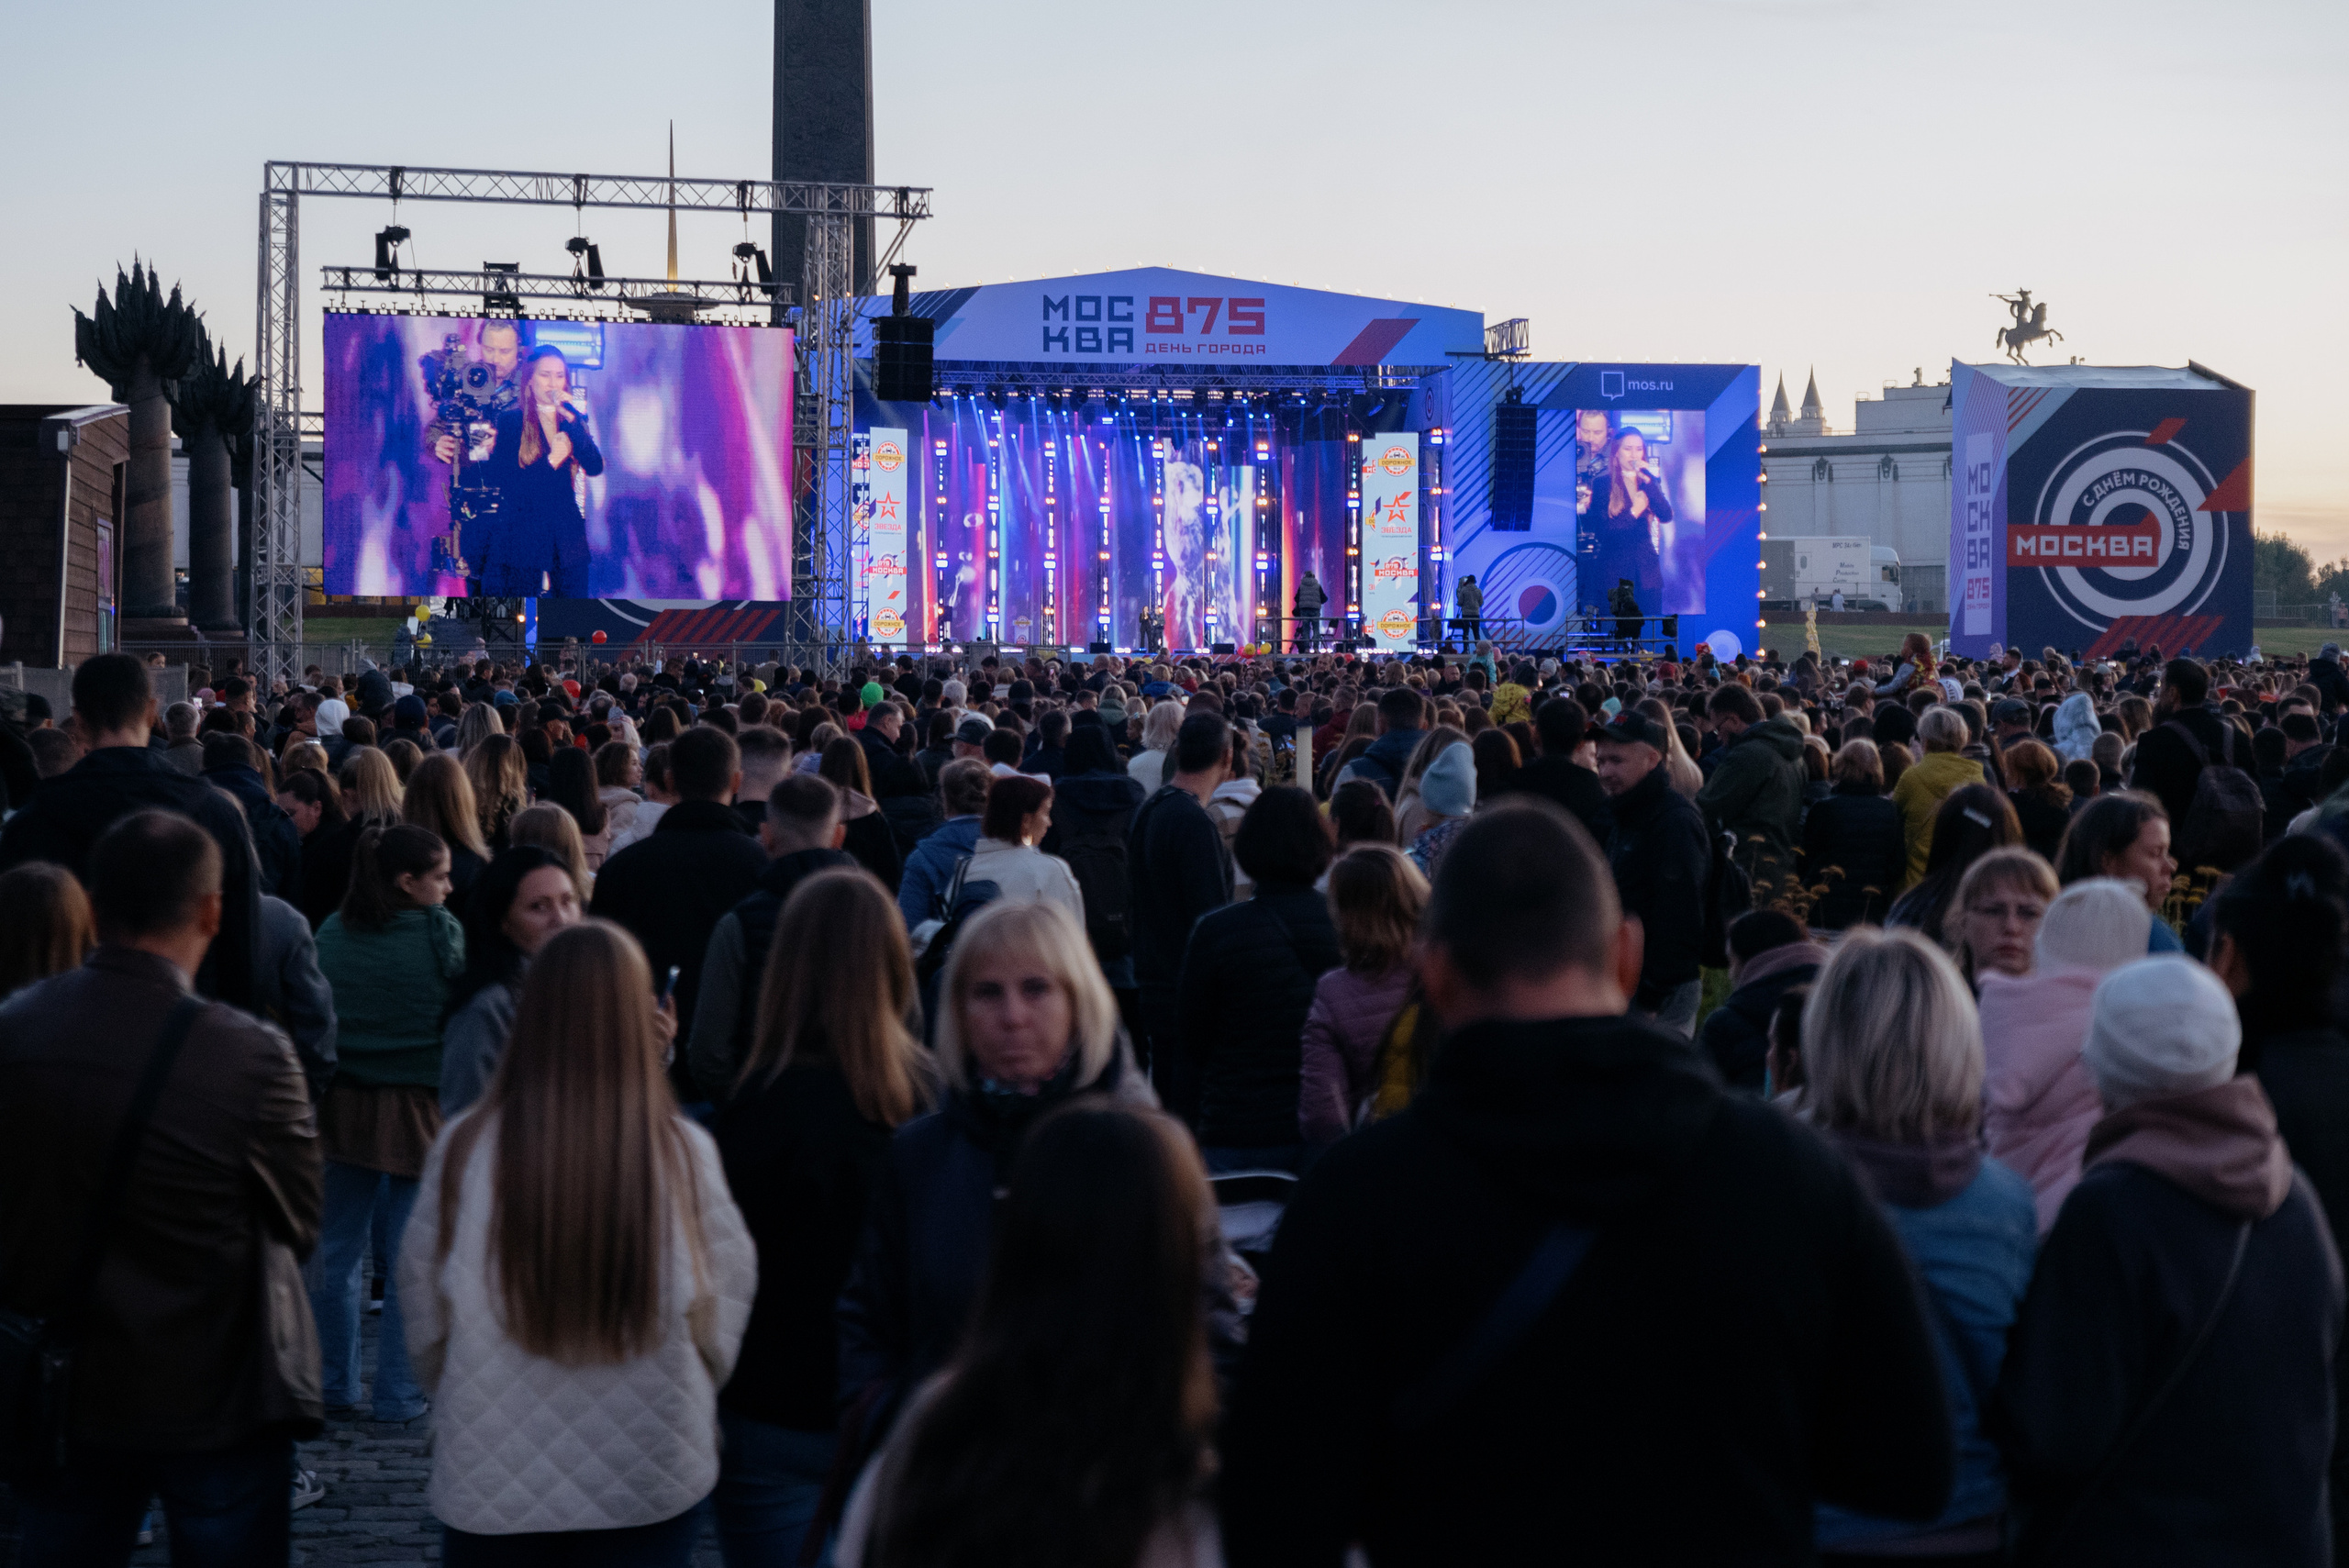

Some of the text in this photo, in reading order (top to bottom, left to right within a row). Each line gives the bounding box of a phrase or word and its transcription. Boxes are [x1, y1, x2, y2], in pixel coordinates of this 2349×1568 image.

[1042, 295, 1134, 322] МОС
[1145, 296, 1265, 335] 875
[1042, 326, 1134, 353] КВА
[1145, 343, 1266, 355] ДЕНЬ ГОРОДА
[1628, 381, 1674, 391] mos.ru
[2083, 471, 2191, 550] С ДНЁМ РОЖДЕНИЯ
[2016, 535, 2154, 557] МОСКВА
[1966, 577, 1990, 600] 875
